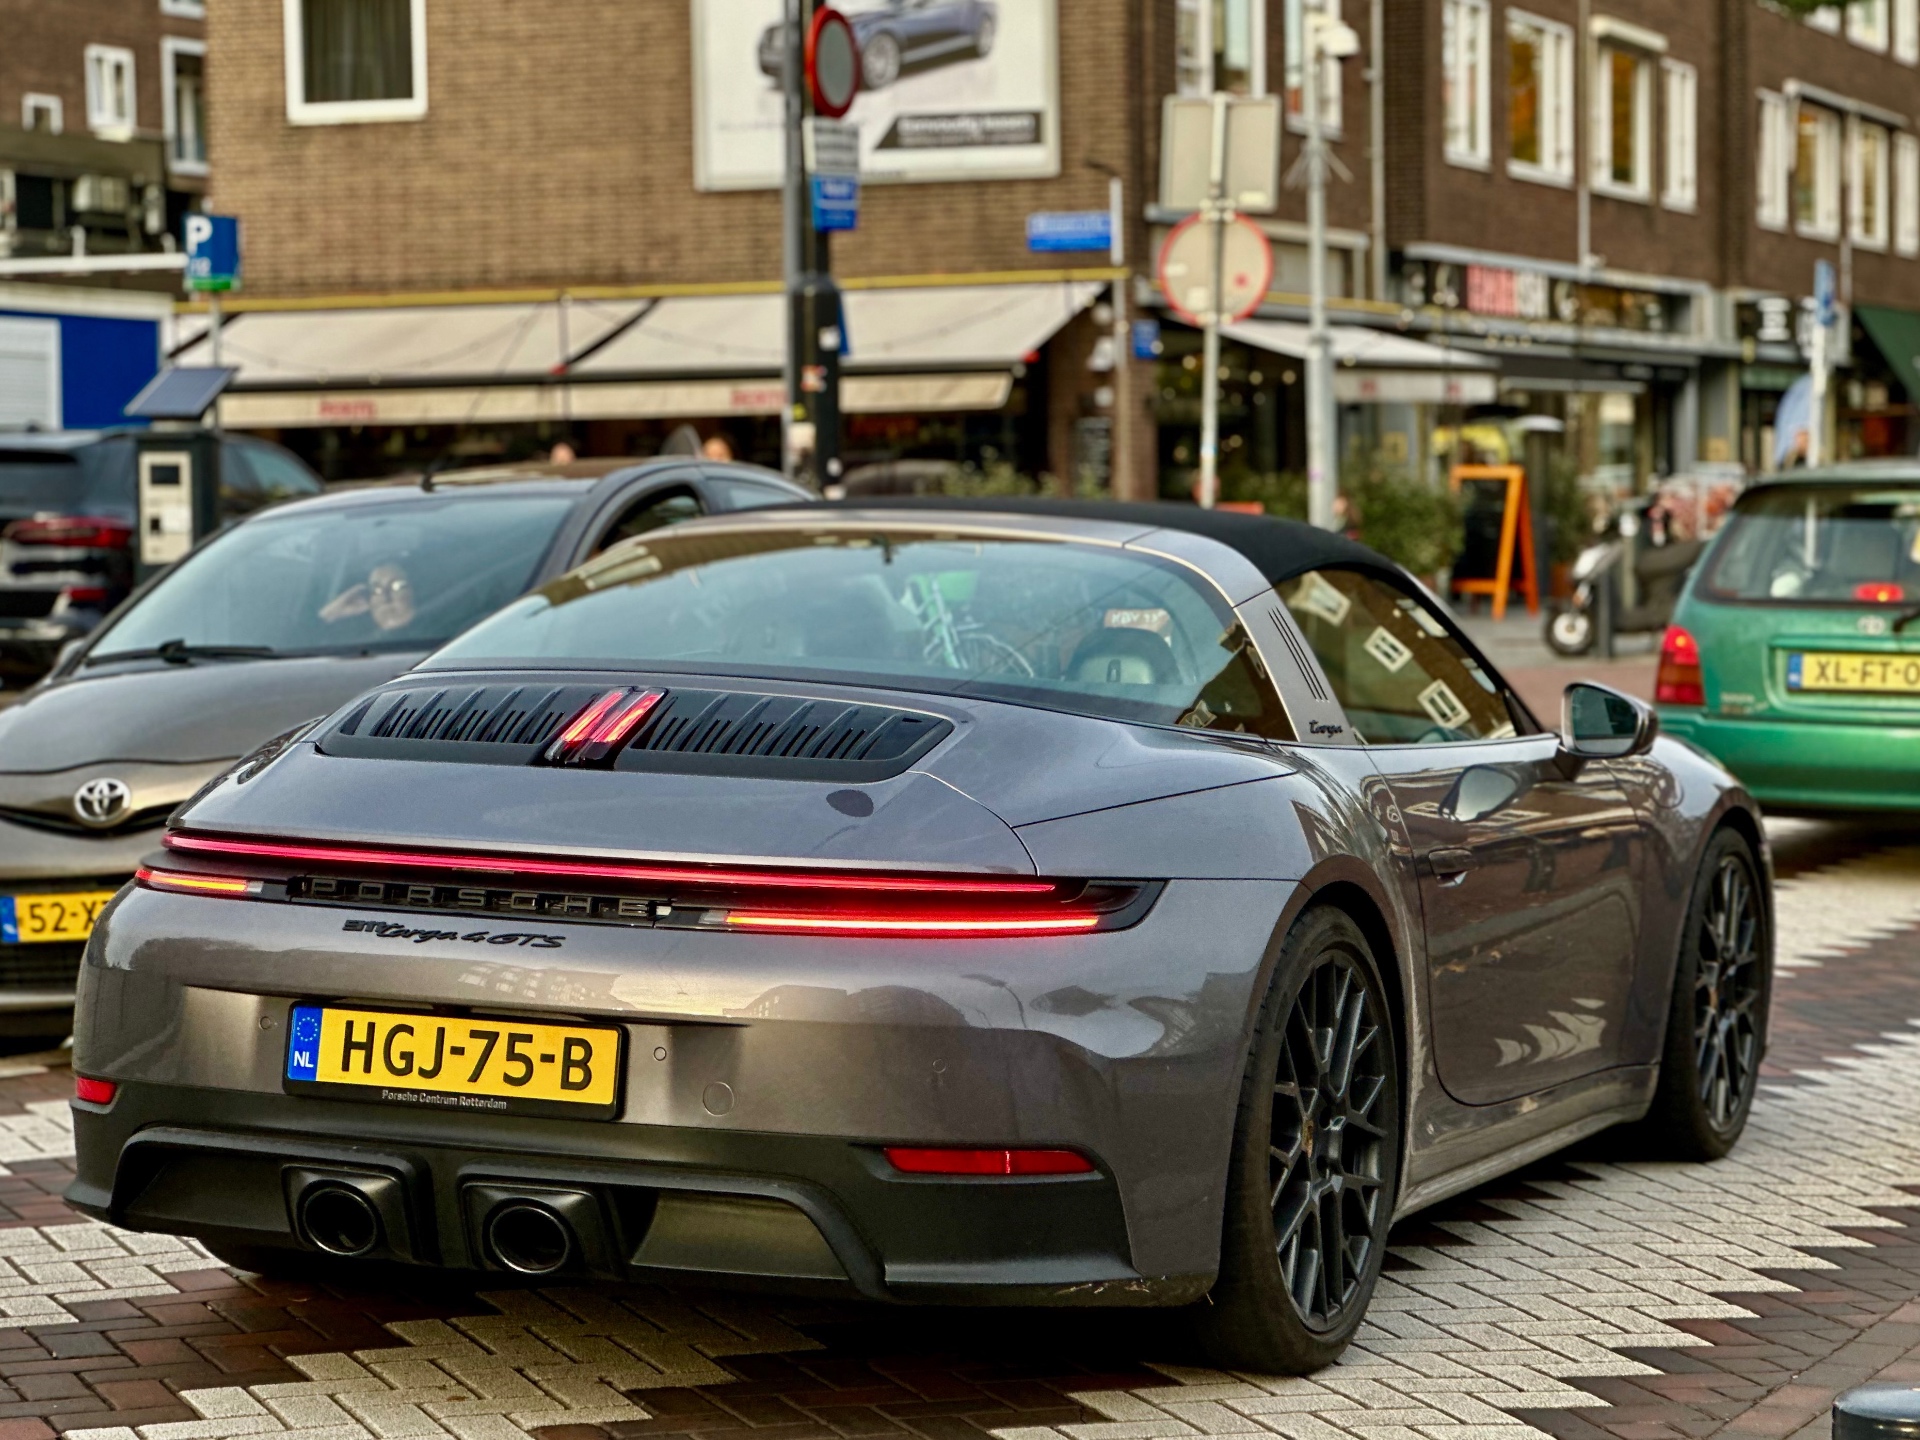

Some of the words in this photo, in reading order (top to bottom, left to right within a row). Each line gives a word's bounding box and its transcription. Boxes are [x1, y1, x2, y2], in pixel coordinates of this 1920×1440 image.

[186, 215, 213, 256] P
[311, 878, 649, 917] PORSCHE
[29, 901, 109, 933] 52-X
[487, 932, 566, 948] GTS
[293, 1051, 314, 1069] NL
[341, 1018, 593, 1092] HGJ-75-B
[381, 1089, 418, 1103] Porsche
[419, 1092, 458, 1106] Centrum
[459, 1095, 507, 1110] Rotterdam
